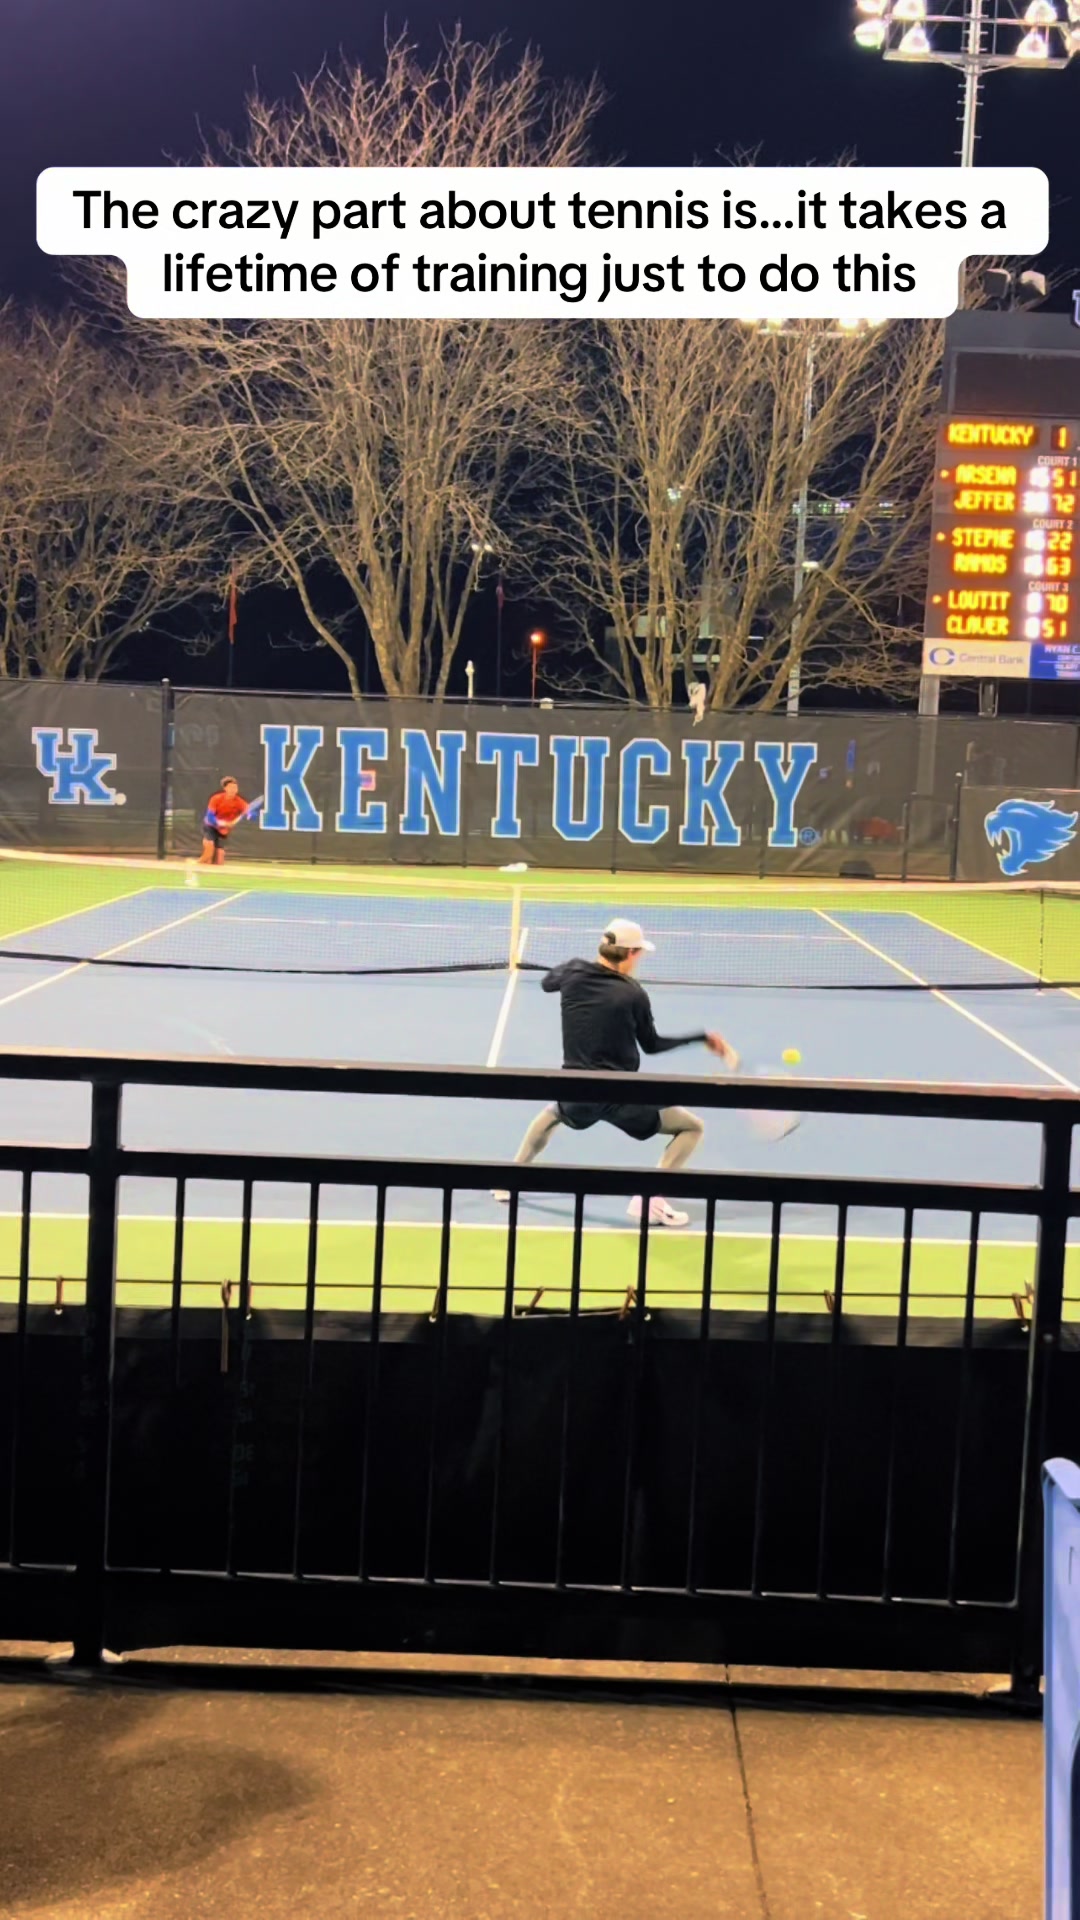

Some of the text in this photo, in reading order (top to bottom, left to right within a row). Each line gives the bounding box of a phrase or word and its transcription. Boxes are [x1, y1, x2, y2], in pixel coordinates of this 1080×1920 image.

[948, 423, 1067, 448] KENTUCKY 1
[1037, 456, 1078, 467] COURT 1
[954, 491, 1015, 511] JEFFER
[1032, 519, 1073, 530] COURT 2
[952, 527, 1015, 549] STEPHE
[954, 552, 1007, 574] RAMOS
[1028, 581, 1060, 592] COURT
[948, 590, 1011, 611] LOUTIT
[960, 653, 996, 664] Central
[998, 654, 1025, 665] Bank
[32, 727, 117, 804] UK
[260, 724, 817, 847] KENTUCKY
